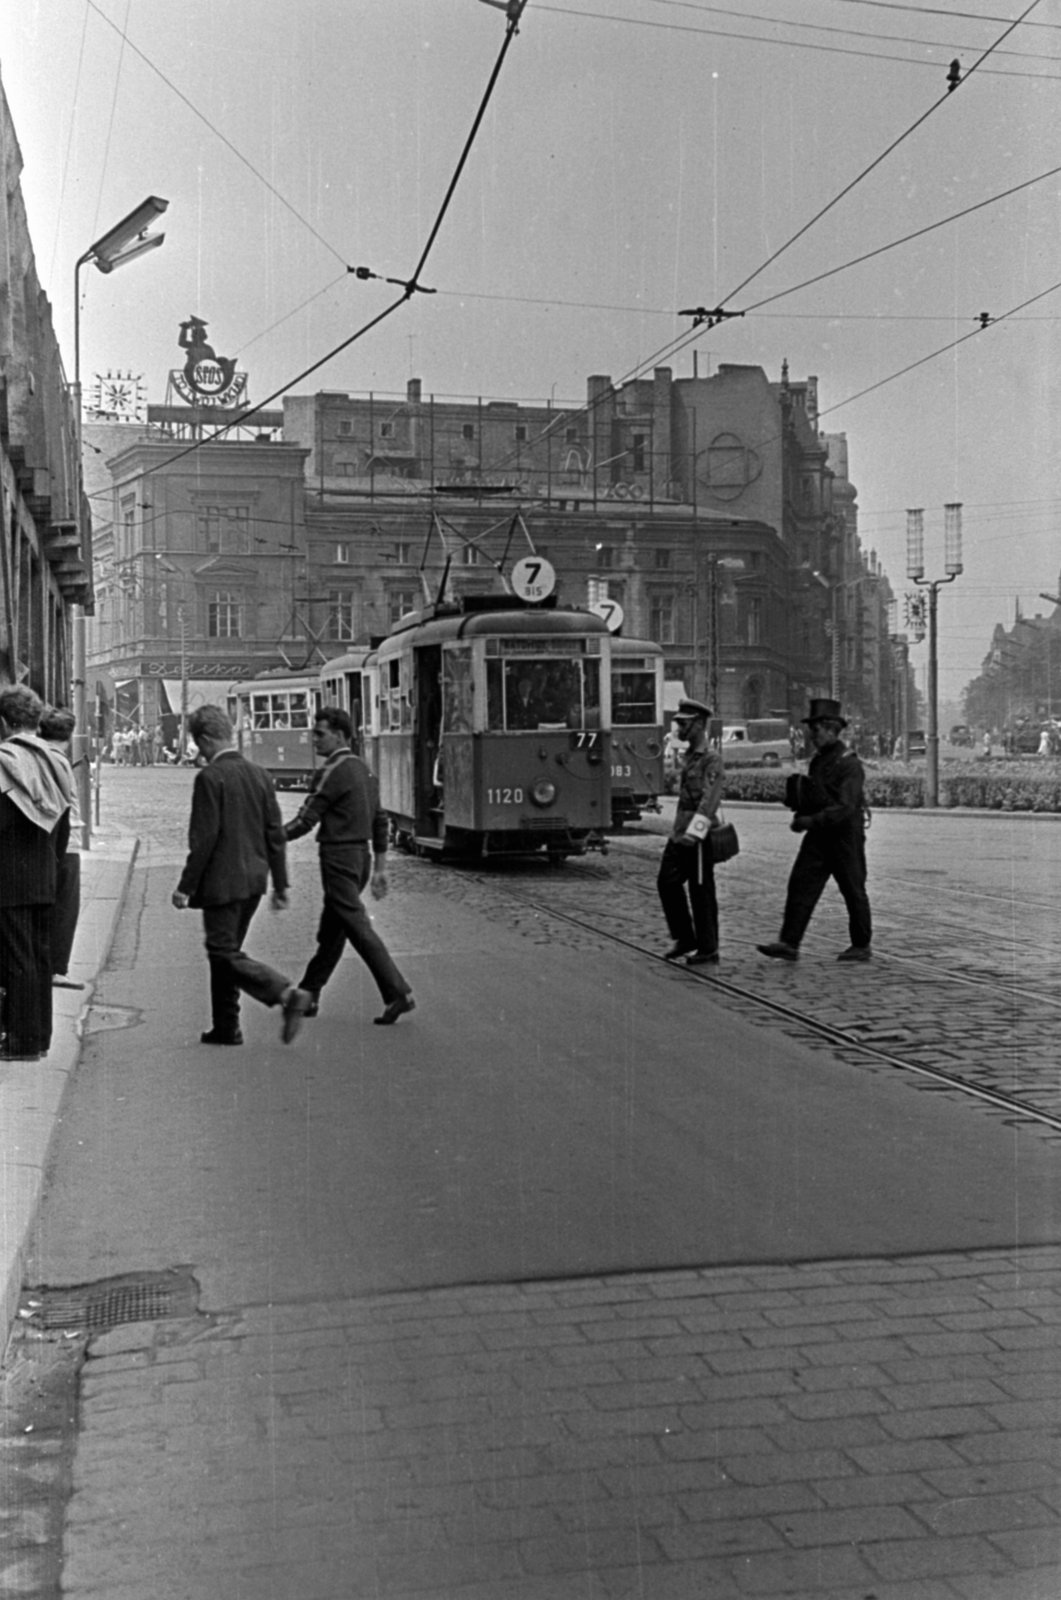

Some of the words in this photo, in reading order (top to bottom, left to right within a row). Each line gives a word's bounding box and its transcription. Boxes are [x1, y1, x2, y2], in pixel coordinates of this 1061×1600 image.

[196, 366, 222, 385] SFOS
[524, 562, 541, 584] 7
[525, 586, 542, 597] BIS
[600, 604, 616, 624] 7
[577, 733, 597, 747] 77
[487, 788, 523, 804] 1120
